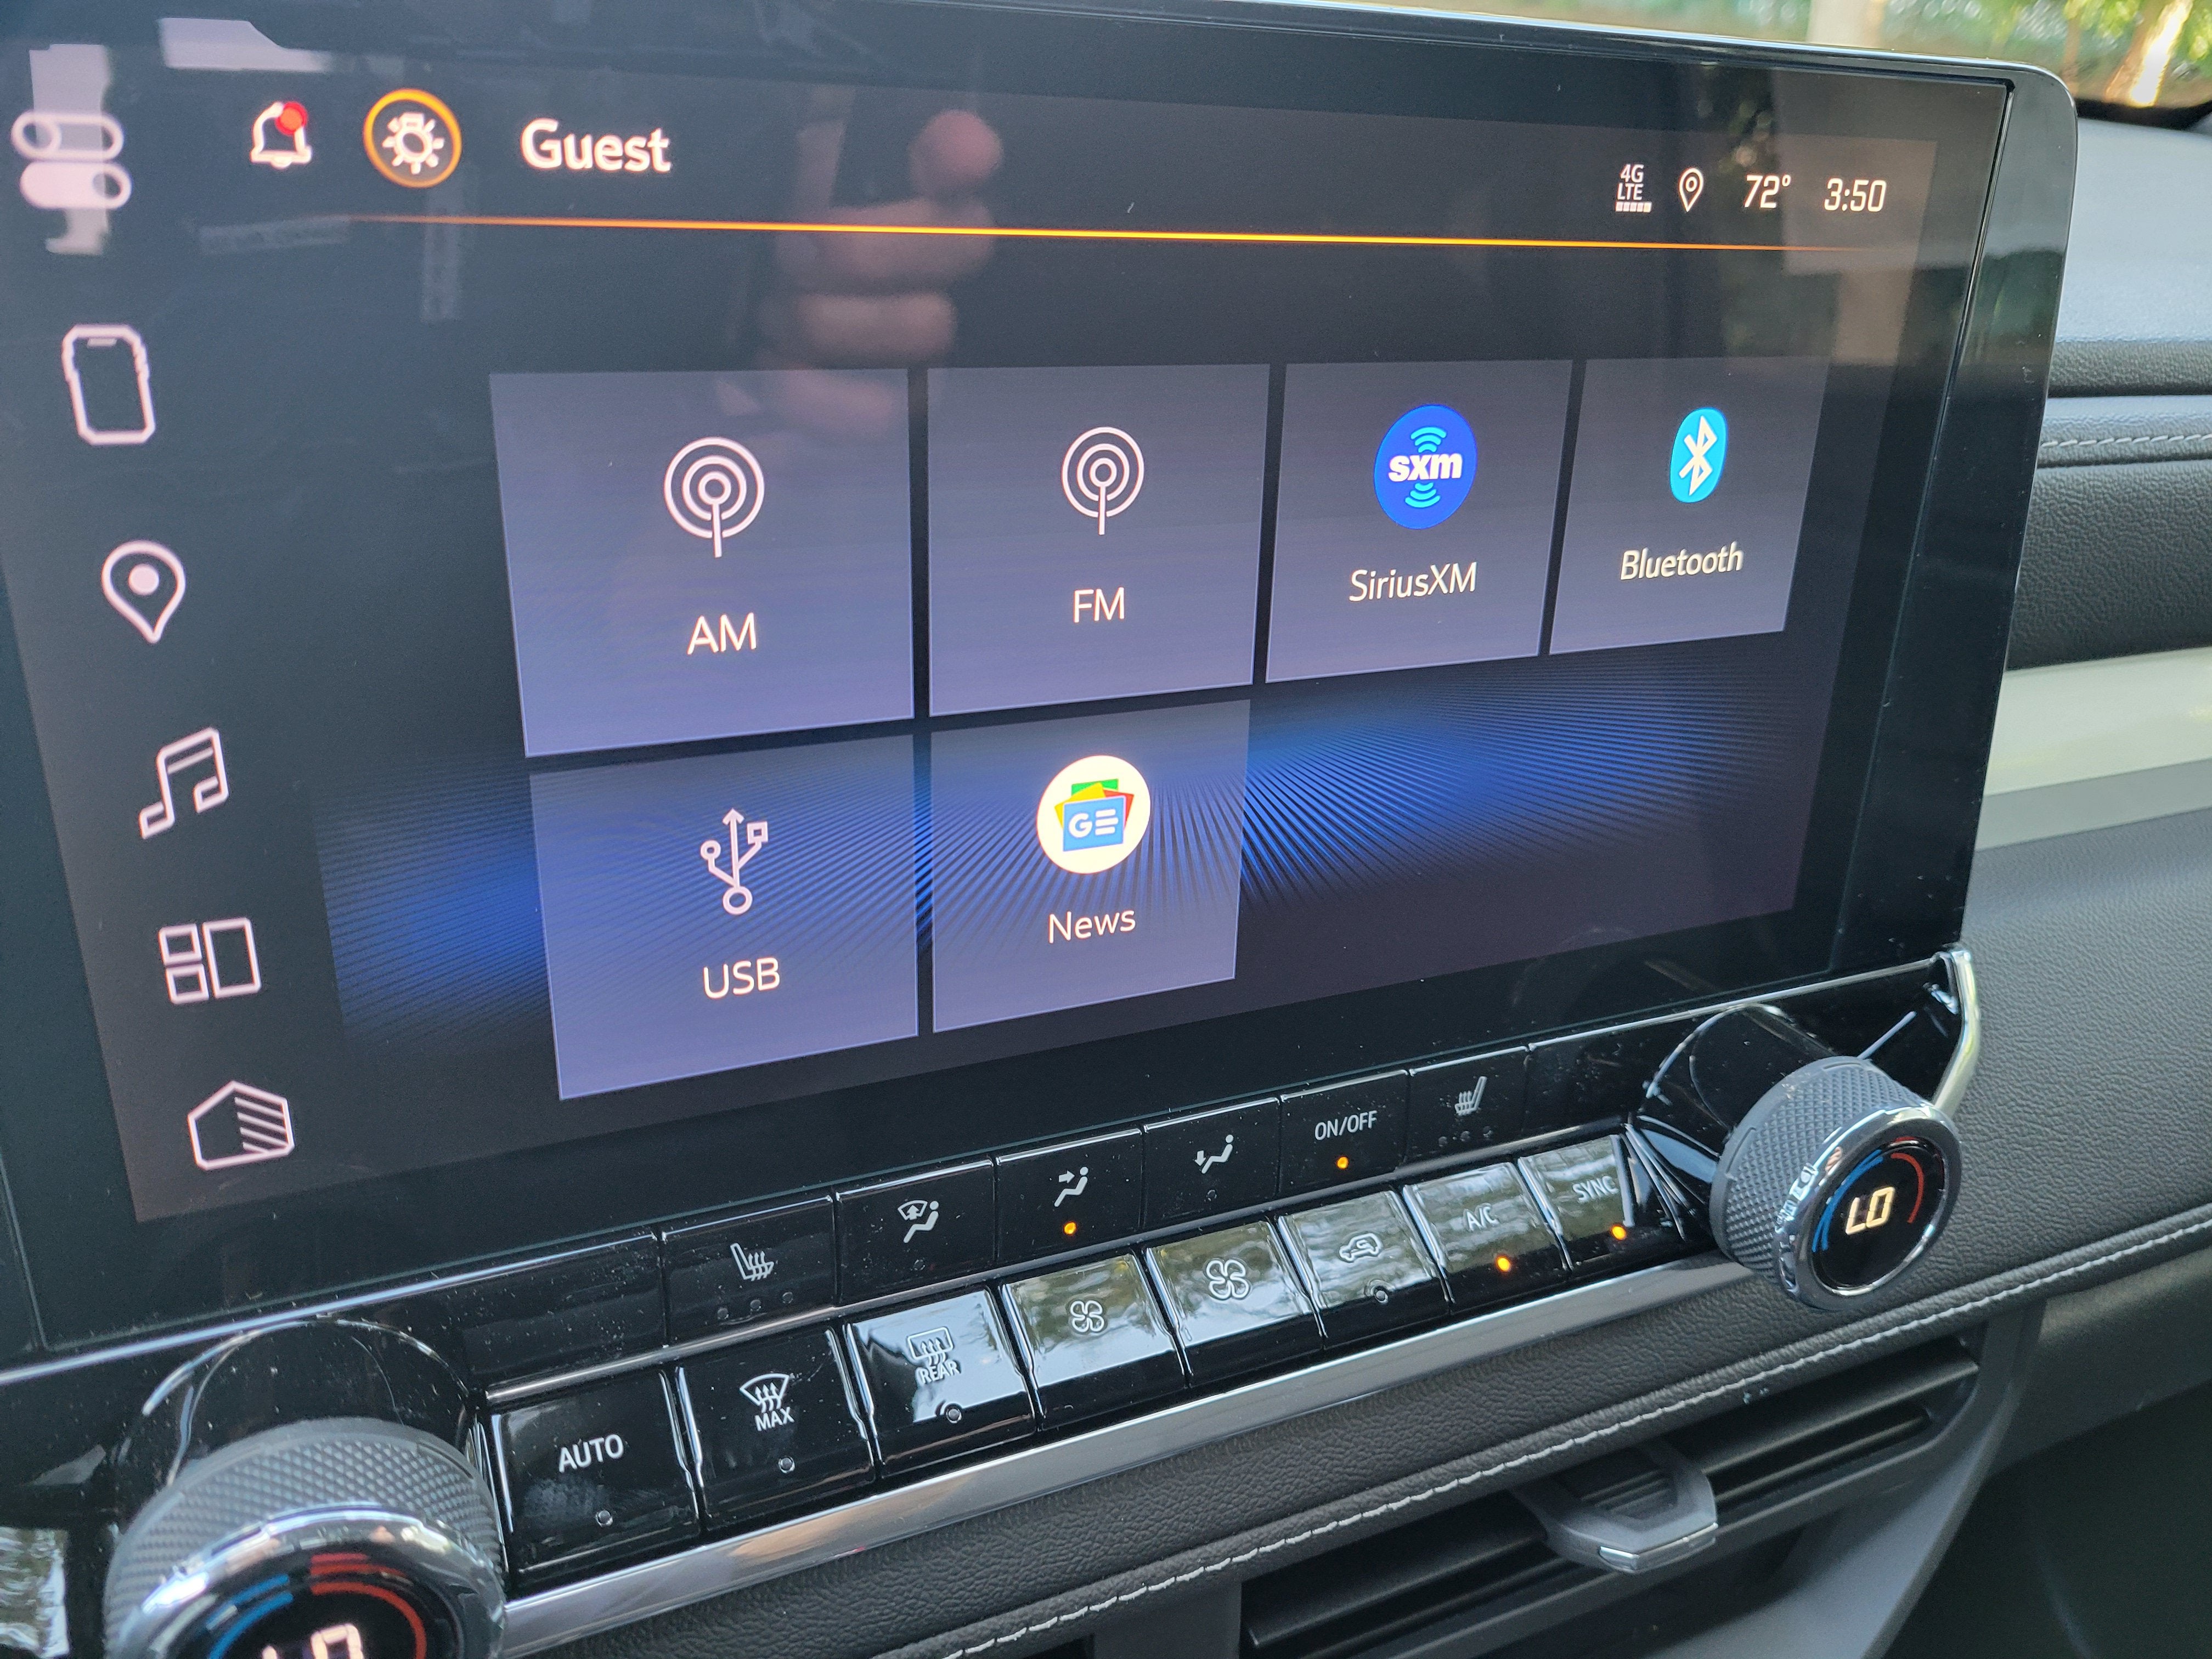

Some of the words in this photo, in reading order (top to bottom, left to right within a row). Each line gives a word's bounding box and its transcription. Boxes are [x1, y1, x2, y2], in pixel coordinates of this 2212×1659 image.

[521, 117, 672, 173] Guest
[1620, 164, 1644, 183] 4G
[1617, 183, 1644, 201] LTE
[1824, 177, 1887, 213] 3:50
[1388, 452, 1463, 483] sxm
[1620, 541, 1745, 582] Bluetooth
[1348, 562, 1477, 602] SiriusXM
[1073, 586, 1125, 623] FM
[687, 612, 757, 655] AM
[1047, 908, 1137, 944] News
[703, 957, 781, 1000] USB
[1314, 1110, 1378, 1141] ON/OFF
[1572, 1174, 1620, 1204] SYNC
[1465, 1205, 1500, 1232] A/C
[915, 1359, 961, 1385] REAR
[754, 1406, 794, 1431] MAX
[557, 1433, 624, 1474] AUTO
